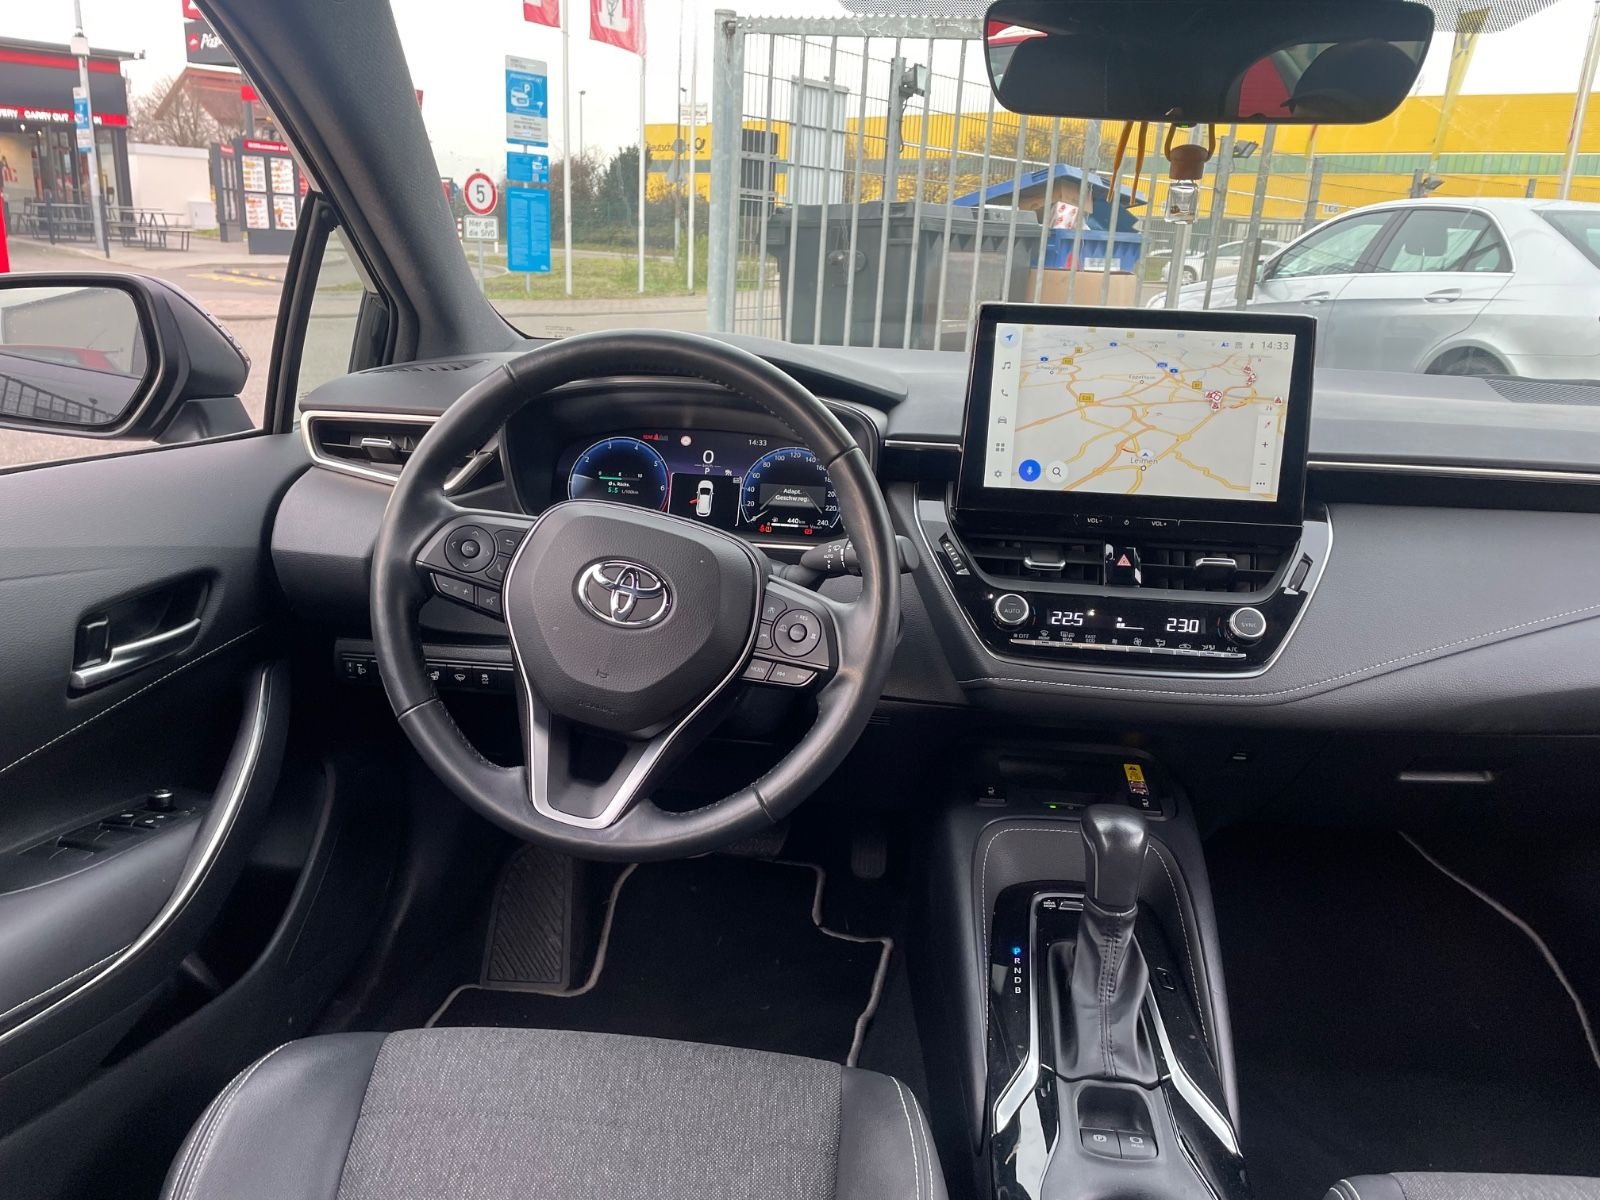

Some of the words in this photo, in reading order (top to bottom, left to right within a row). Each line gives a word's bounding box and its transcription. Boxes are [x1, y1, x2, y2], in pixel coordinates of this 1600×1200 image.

[23, 109, 51, 121] CARRY
[52, 112, 69, 123] OUT
[476, 184, 485, 204] 5
[1261, 341, 1289, 350] 14:33
[748, 439, 768, 447] 14:33
[702, 449, 714, 464] 0
[704, 467, 711, 475] P
[1014, 947, 1021, 955] P
[1014, 976, 1022, 984] D
[1014, 986, 1022, 994] B
